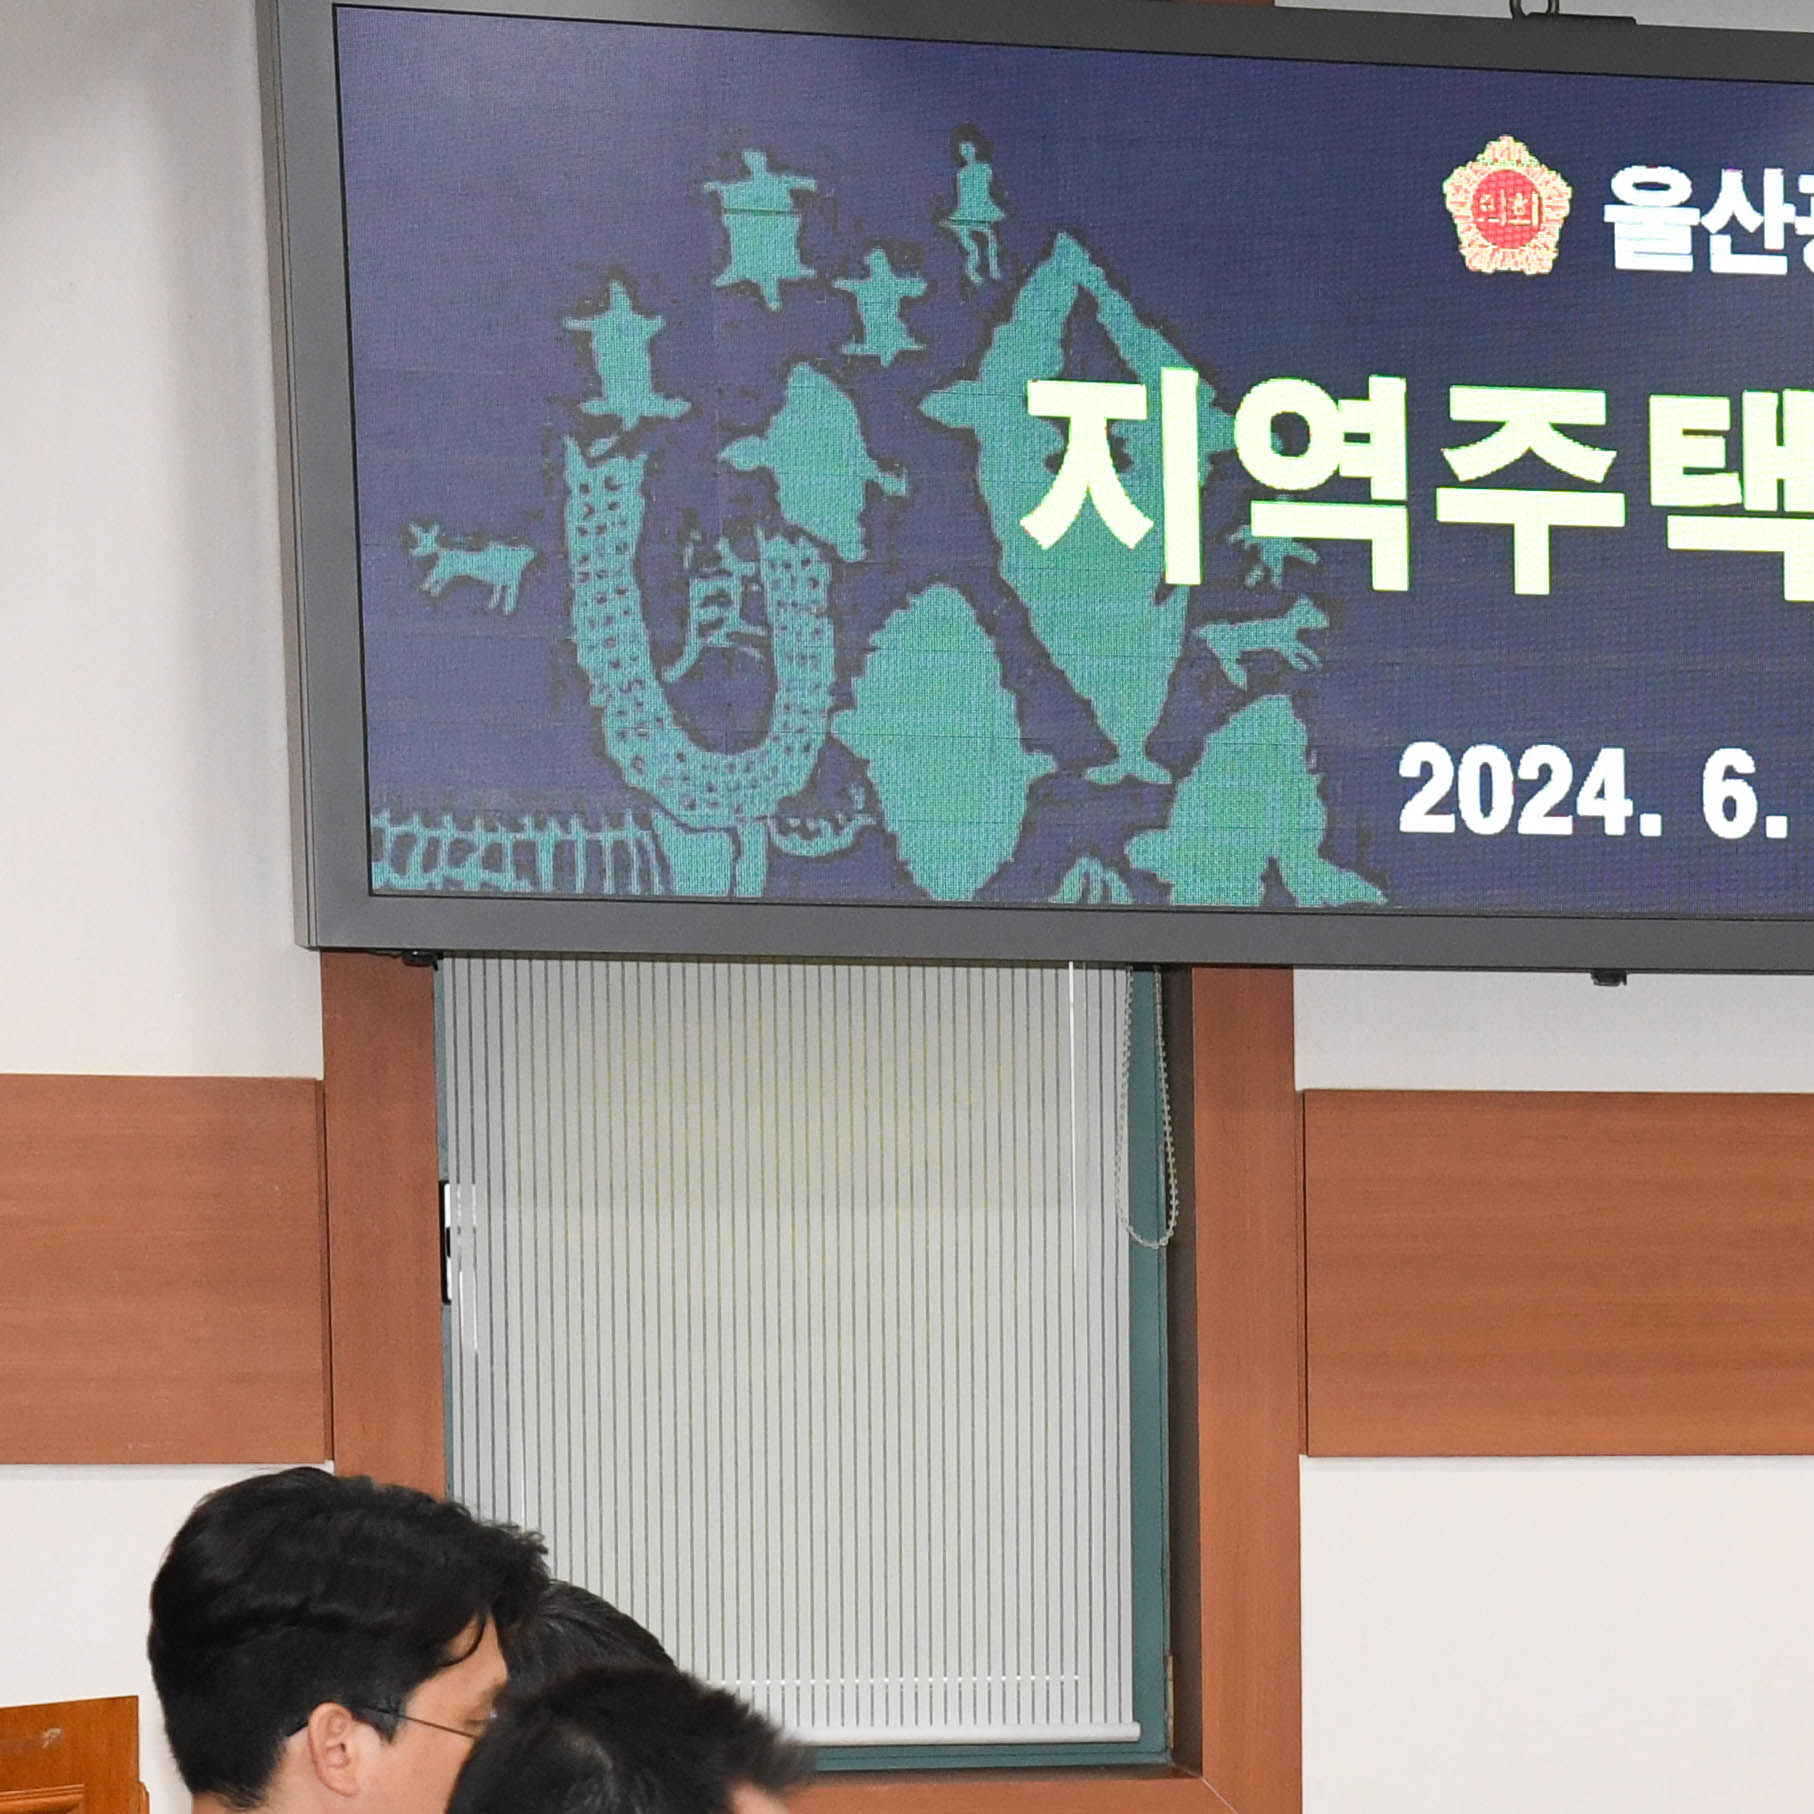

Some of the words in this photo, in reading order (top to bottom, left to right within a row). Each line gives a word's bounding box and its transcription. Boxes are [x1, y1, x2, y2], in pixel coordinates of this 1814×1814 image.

[1477, 189, 1540, 227] 의회
[1400, 742, 1661, 836] 2024.
[1704, 749, 1787, 838] 6.
